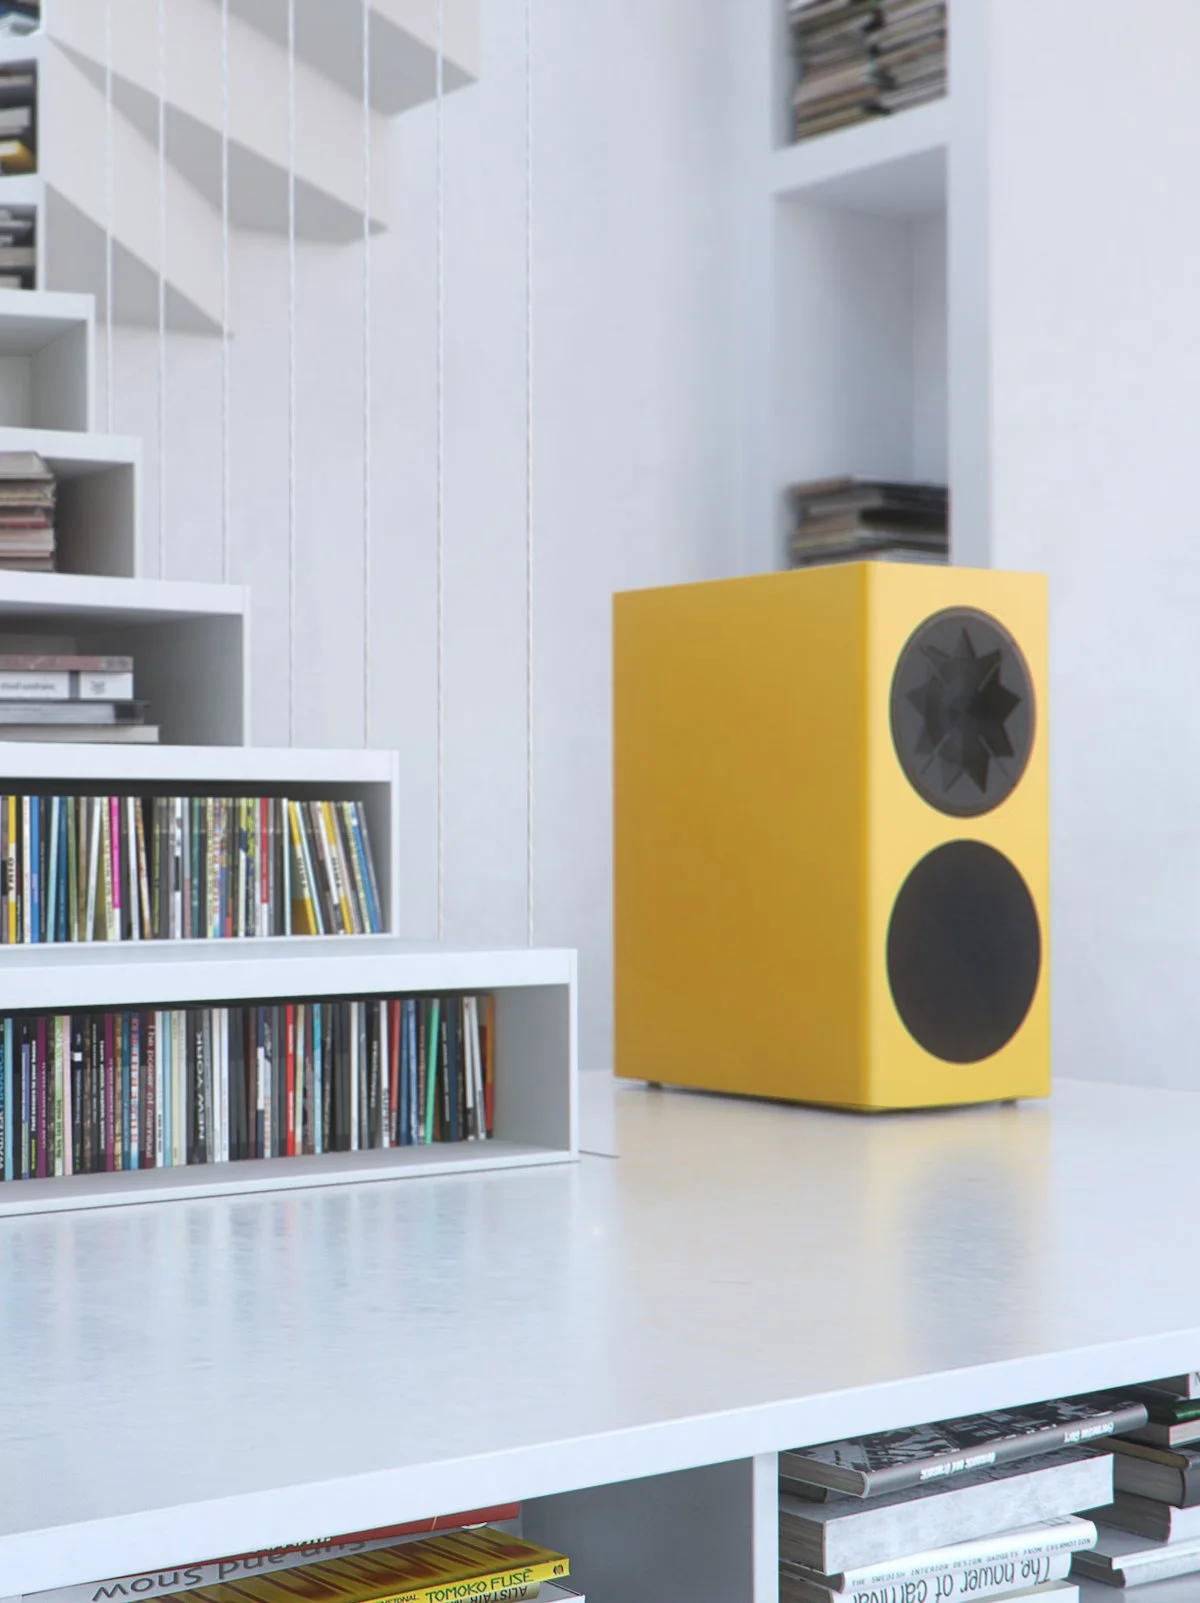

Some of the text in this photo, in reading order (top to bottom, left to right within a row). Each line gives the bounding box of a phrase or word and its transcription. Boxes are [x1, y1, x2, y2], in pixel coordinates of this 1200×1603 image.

[195, 1031, 203, 1087] YORK
[852, 1578, 865, 1587] THE
[871, 1571, 906, 1583] SWEDISH
[911, 1563, 949, 1577] INTERIOR
[952, 1556, 981, 1569] DESIGN
[425, 1581, 487, 1603] TOMOKO
